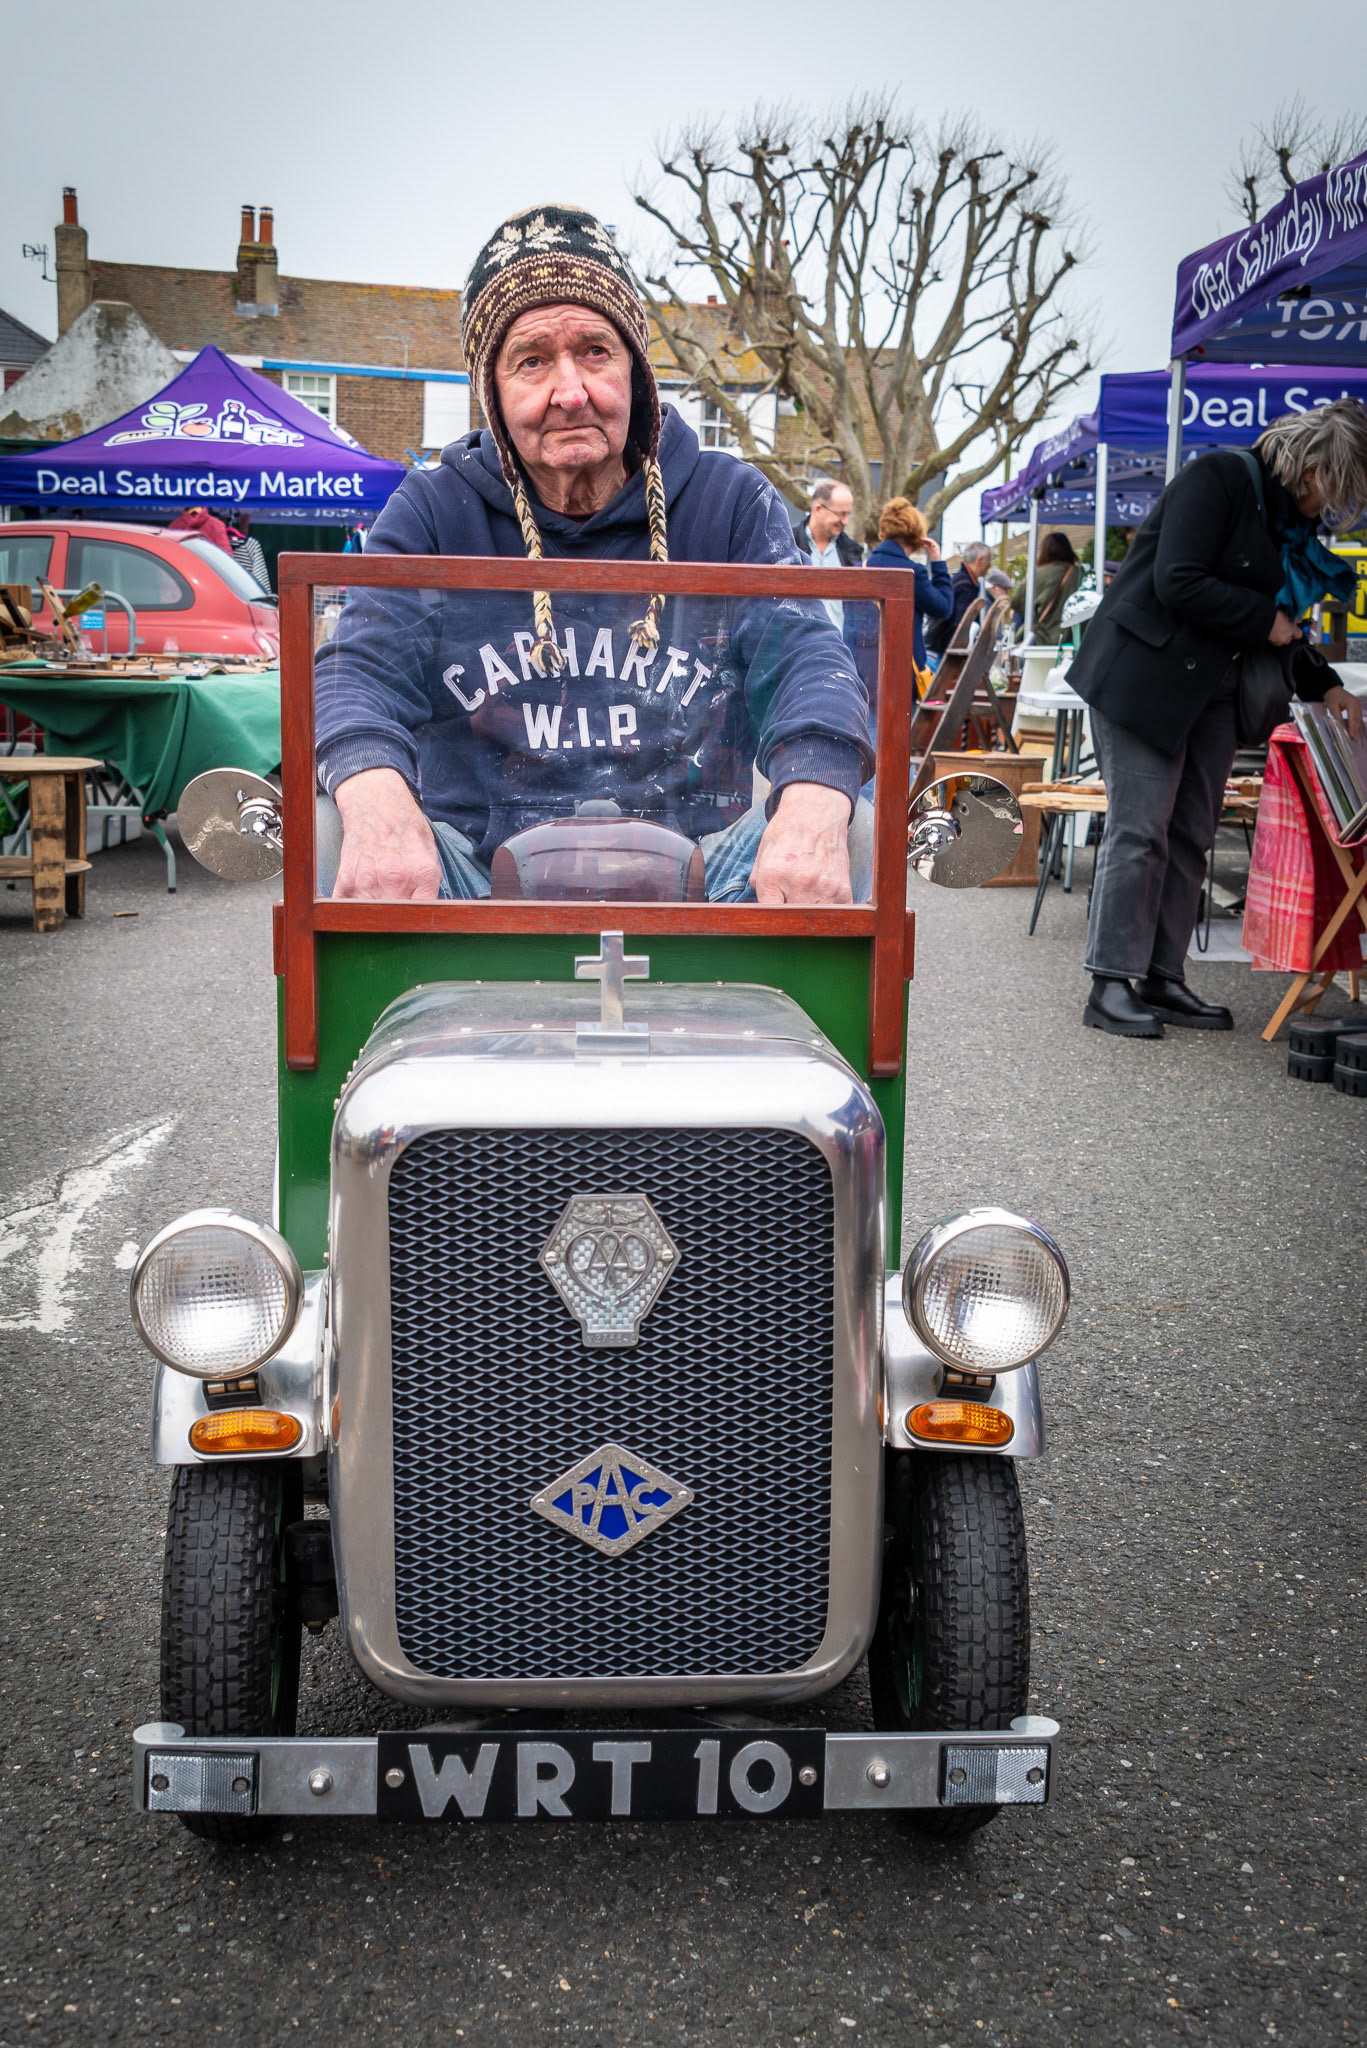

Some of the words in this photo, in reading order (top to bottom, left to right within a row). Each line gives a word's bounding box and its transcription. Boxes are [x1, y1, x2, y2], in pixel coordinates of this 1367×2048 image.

[1191, 242, 1236, 320] Deal
[1236, 188, 1324, 294] Saturday
[1325, 163, 1367, 240] Mar
[1166, 387, 1269, 428] Deal
[37, 469, 108, 496] Deal
[116, 469, 250, 502] Saturday
[260, 470, 364, 498] Market
[442, 627, 713, 712] CARHARTT
[408, 1741, 652, 1818] WRT
[693, 1738, 792, 1814] 10
